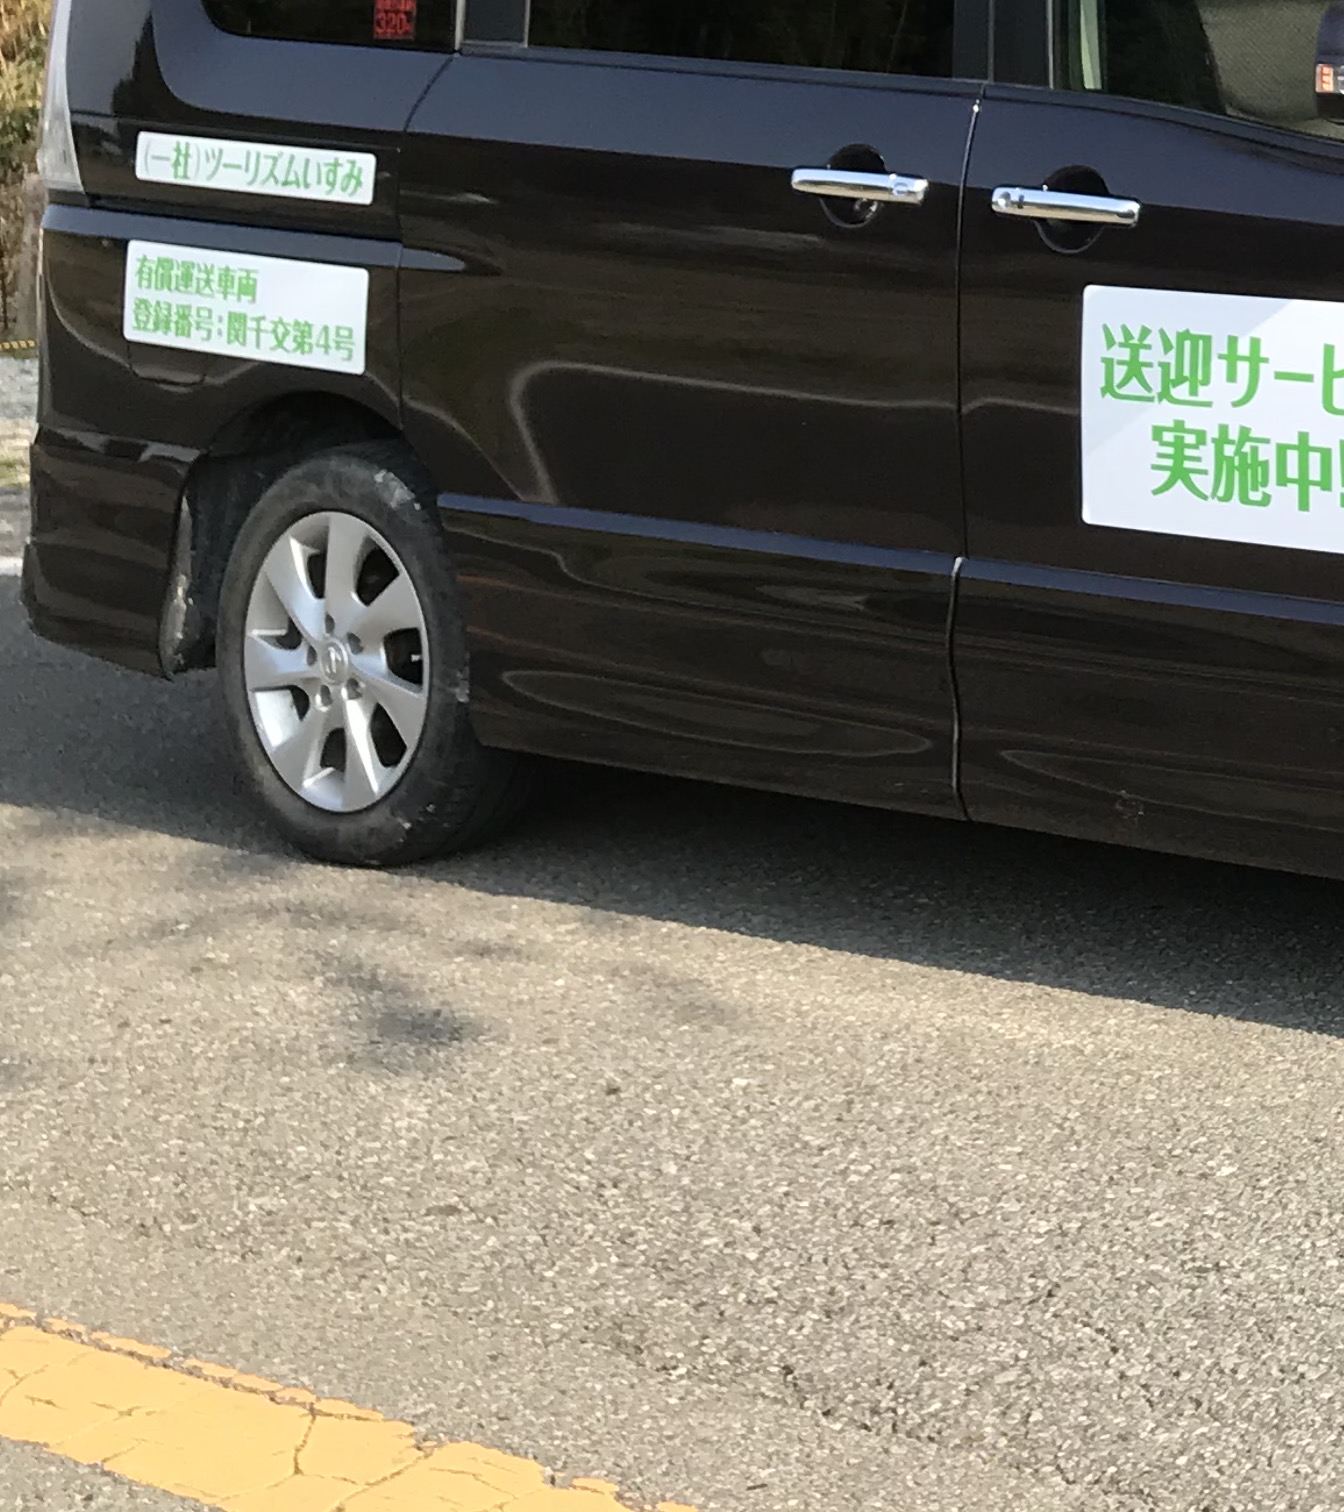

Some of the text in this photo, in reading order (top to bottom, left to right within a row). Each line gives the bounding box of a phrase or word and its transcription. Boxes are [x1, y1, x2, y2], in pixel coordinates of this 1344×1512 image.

[144, 138, 364, 197] (一社)ツーリズムいすみ
[135, 254, 259, 304] 有償運送車両
[132, 297, 356, 362] 登録番号:関千交第4号
